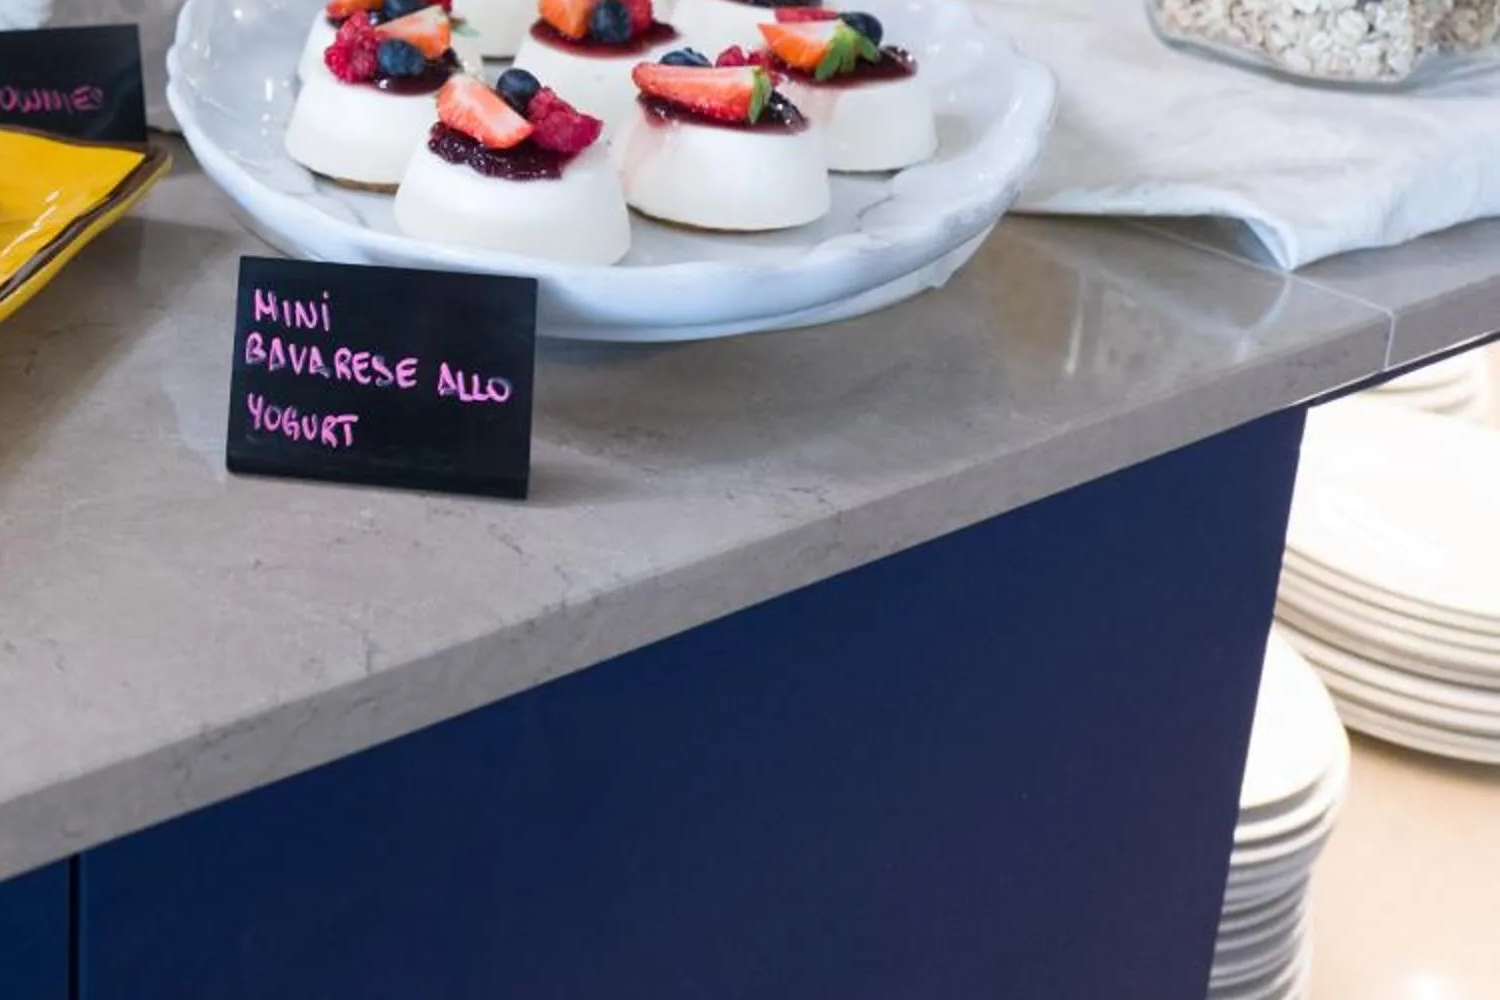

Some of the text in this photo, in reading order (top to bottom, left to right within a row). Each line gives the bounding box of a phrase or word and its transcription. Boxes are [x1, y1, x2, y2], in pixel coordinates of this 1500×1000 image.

[245, 332, 512, 402] BAVARESE ALLO
[247, 394, 358, 448] YOGURT
